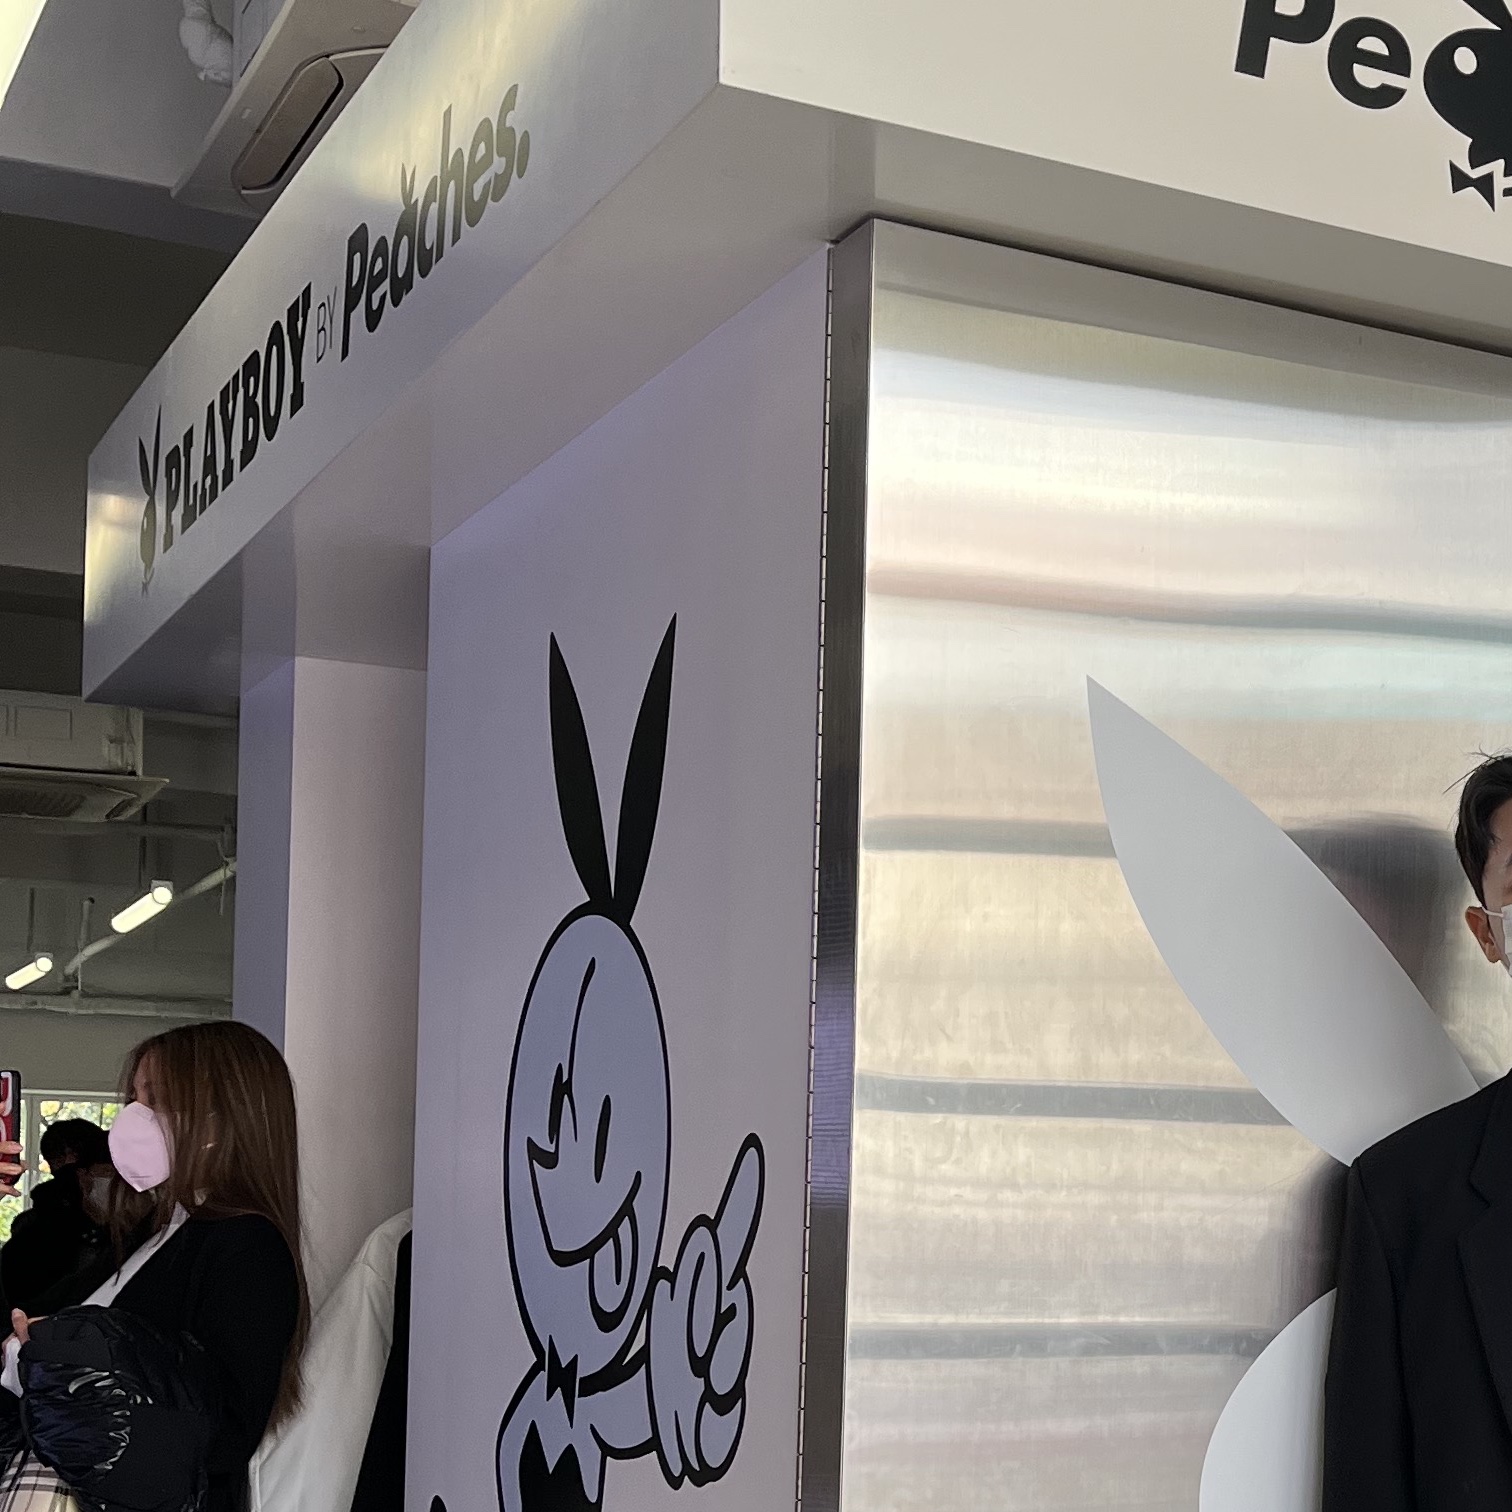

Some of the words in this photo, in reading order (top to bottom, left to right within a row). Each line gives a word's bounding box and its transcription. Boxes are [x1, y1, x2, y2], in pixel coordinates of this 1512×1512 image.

[163, 281, 312, 554] PLAYBOY
[316, 285, 337, 364] BY
[341, 83, 530, 362] Peaches.
